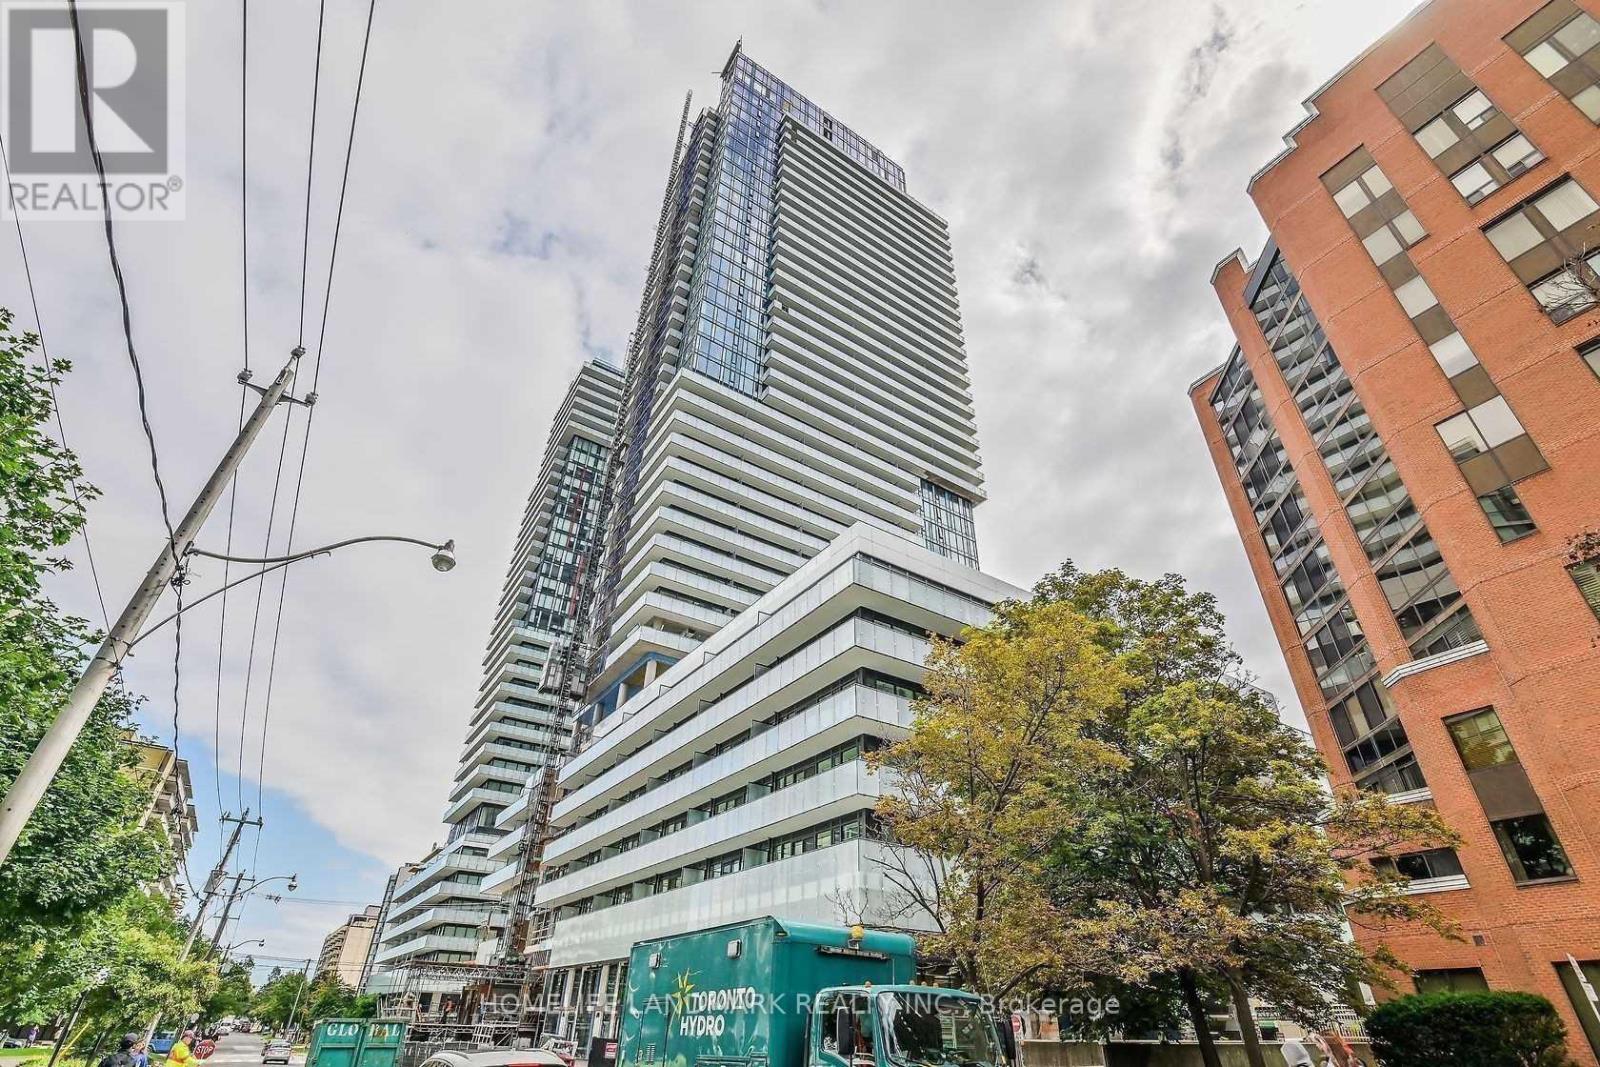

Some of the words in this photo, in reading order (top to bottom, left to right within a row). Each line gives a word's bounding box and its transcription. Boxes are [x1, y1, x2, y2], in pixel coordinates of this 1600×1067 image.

[691, 986, 756, 1012] TORONTO
[680, 1014, 725, 1037] HYDRO
[195, 1045, 214, 1054] STOP
